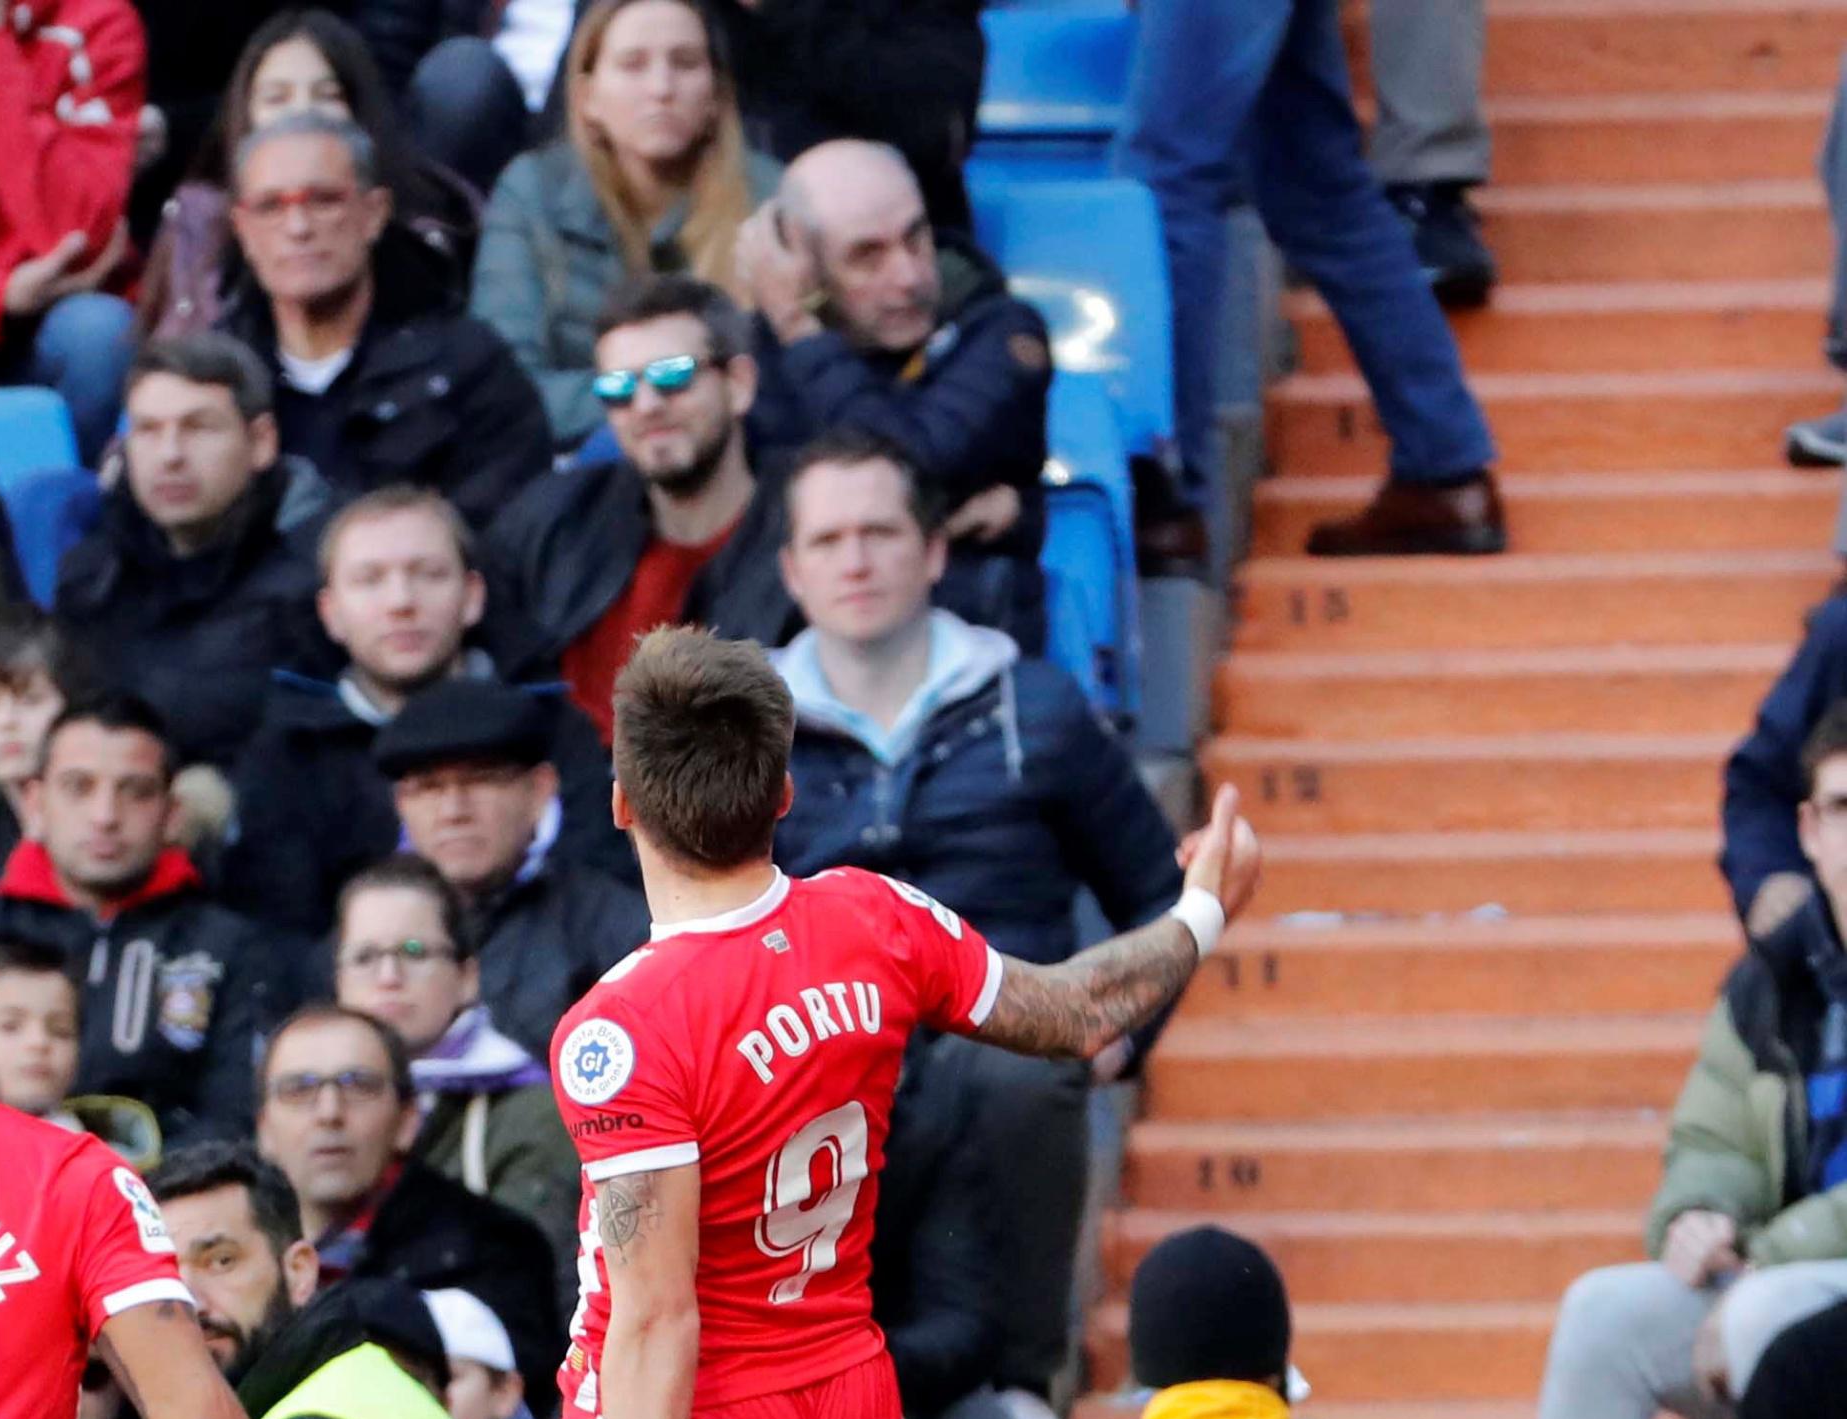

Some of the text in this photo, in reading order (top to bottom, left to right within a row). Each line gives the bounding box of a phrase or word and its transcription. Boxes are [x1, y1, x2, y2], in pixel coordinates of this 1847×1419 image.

[596, 1025, 625, 1056] Brava
[736, 980, 881, 1085] PORTU
[568, 1112, 645, 1139] umbro
[754, 1099, 869, 1306] 9
